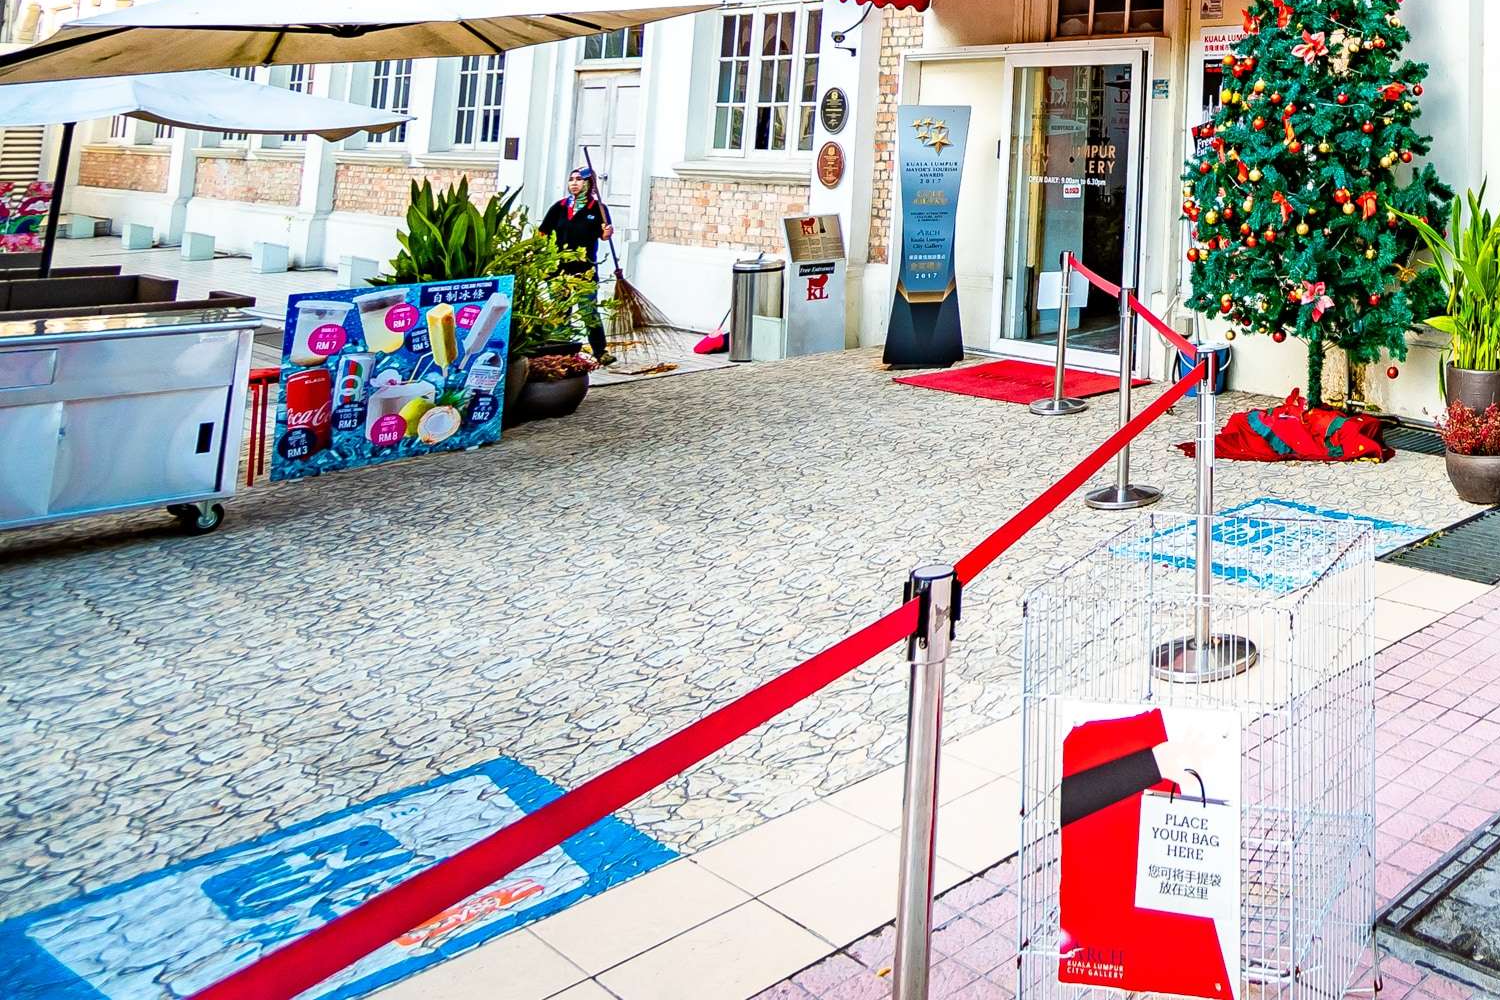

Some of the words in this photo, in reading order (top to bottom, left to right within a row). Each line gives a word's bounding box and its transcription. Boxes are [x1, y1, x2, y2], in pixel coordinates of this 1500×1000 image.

[1204, 34, 1226, 43] KUALA
[315, 342, 329, 350] RM
[1165, 813, 1209, 831] PLACE
[1151, 826, 1188, 843] YOUR
[1191, 832, 1220, 848] BAG
[1167, 844, 1204, 861] HERE
[1148, 863, 1222, 888] 您可将手提袋
[1159, 880, 1209, 901] 放在这里
[1066, 959, 1091, 969] KUALA
[1093, 962, 1124, 972] LUMPUR
[1066, 966, 1085, 975] CITY
[1087, 969, 1124, 980] GALLERY
